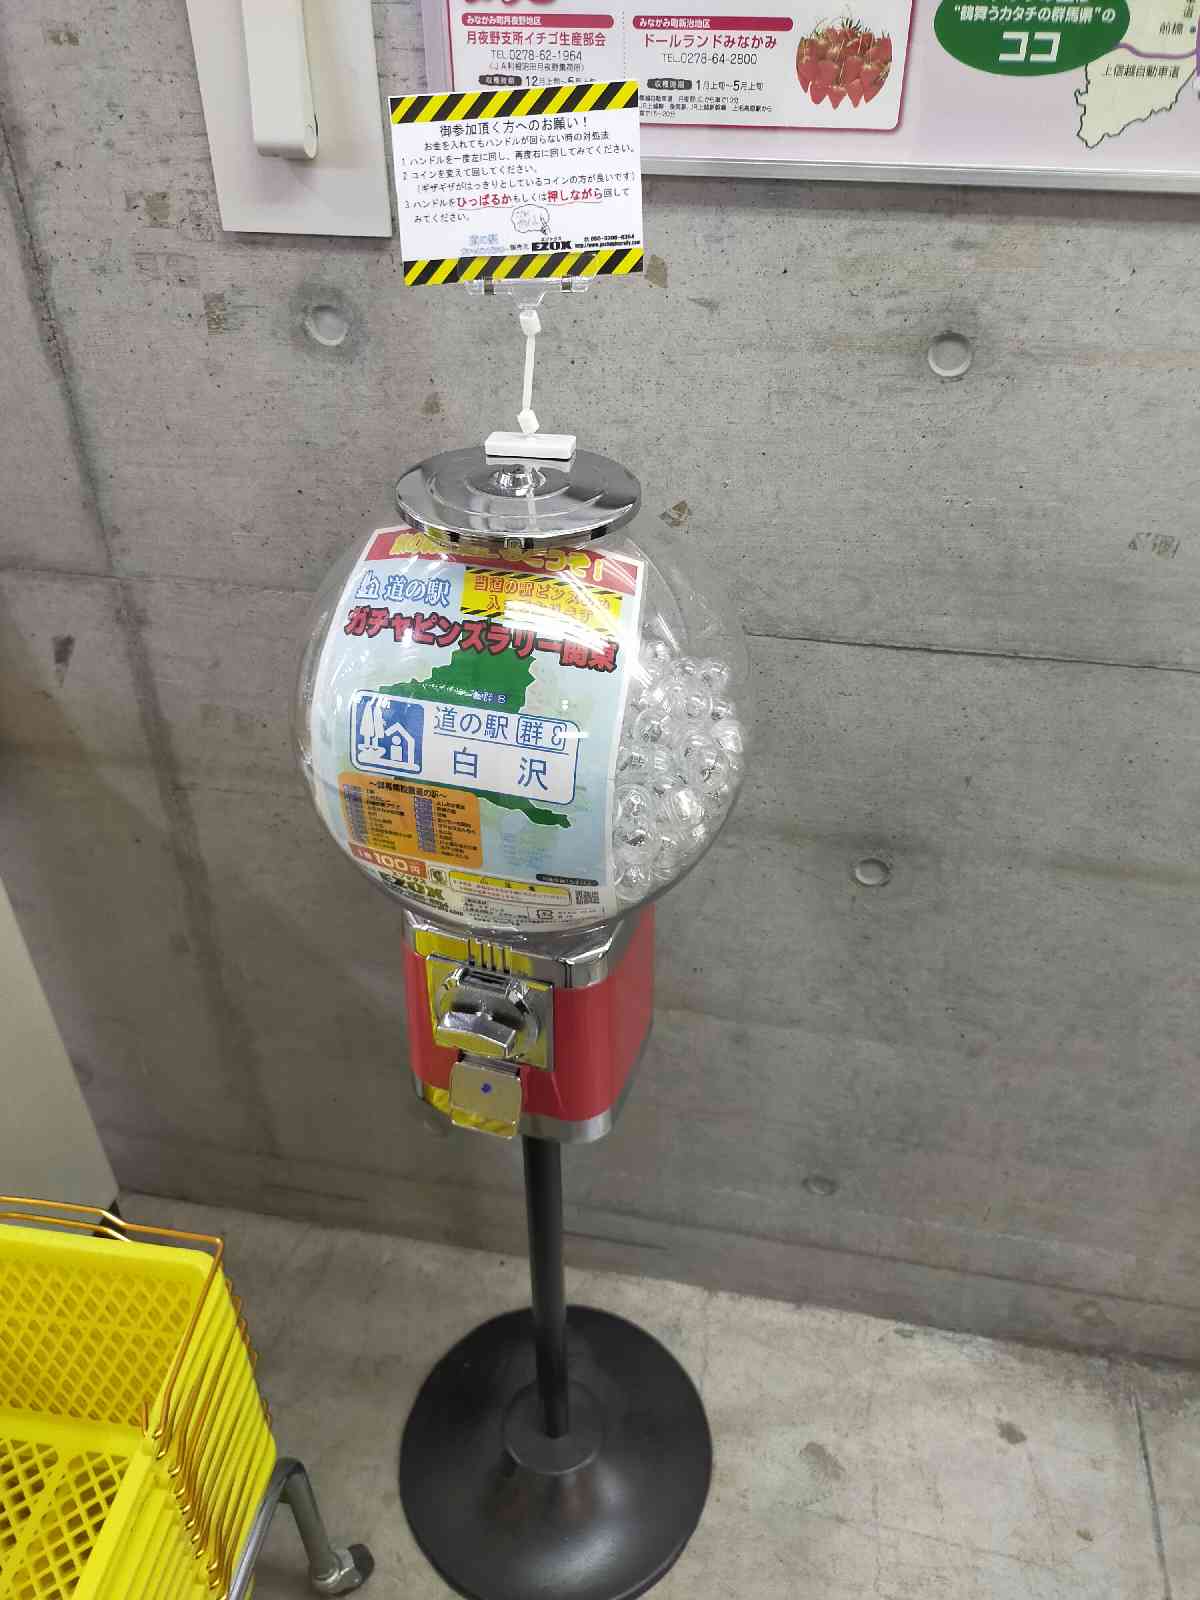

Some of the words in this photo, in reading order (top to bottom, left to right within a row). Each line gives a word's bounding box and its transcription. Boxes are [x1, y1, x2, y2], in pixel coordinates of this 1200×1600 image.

[467, 31, 607, 46] 月夜野支所イチゴ生産部会
[643, 33, 777, 48] ドールランドみなかみ
[999, 31, 1061, 62] ココ
[1104, 64, 1180, 79] 上信越自動車道
[424, 131, 609, 151] お金を入れてもハンドルが回らない時の対処法
[384, 575, 451, 608] 道の駅
[434, 705, 509, 740] 道の駅
